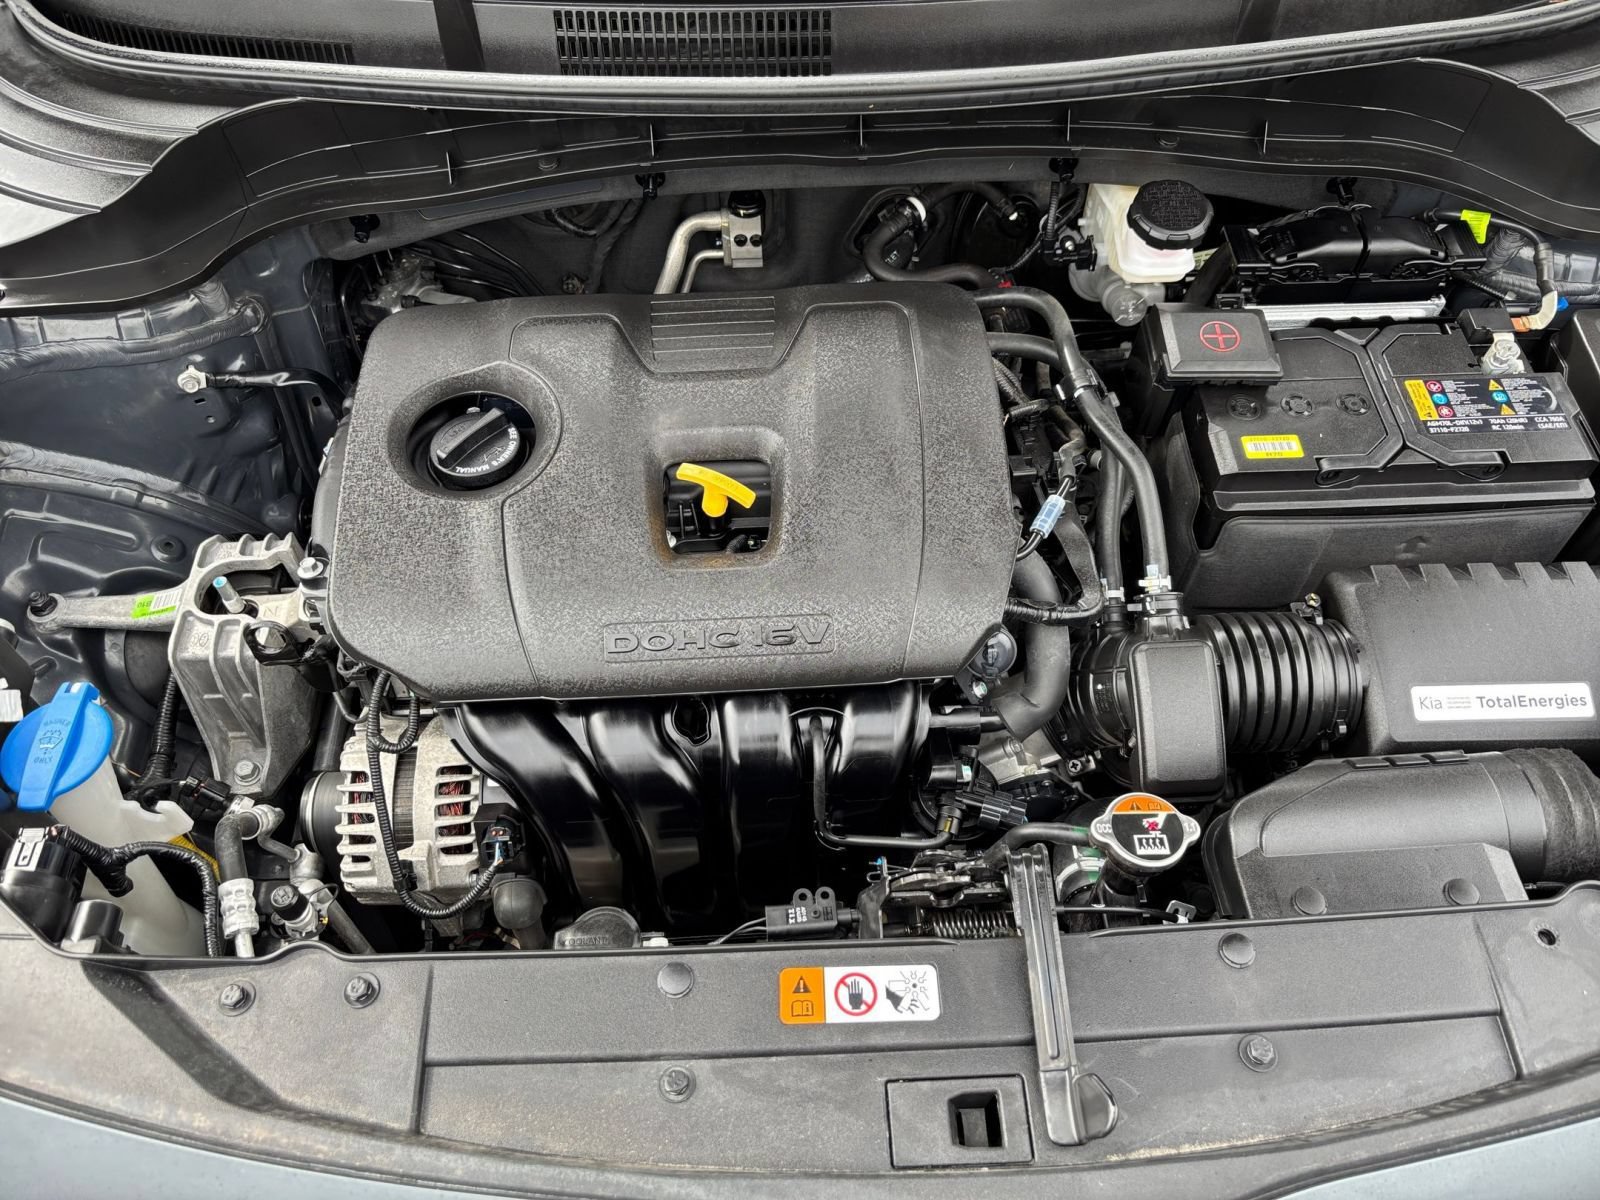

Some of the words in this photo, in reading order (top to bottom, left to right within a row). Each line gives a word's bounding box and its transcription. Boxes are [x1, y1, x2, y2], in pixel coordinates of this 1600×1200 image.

[508, 427, 518, 439] SEE
[491, 440, 517, 466] OWNER'S
[455, 464, 490, 473] MANUAL
[607, 628, 740, 654] DOHC
[751, 622, 830, 647] 16V
[1418, 696, 1443, 710] Kia
[1476, 694, 1587, 710] TotalEnergies
[1183, 822, 1196, 832] 1.1
